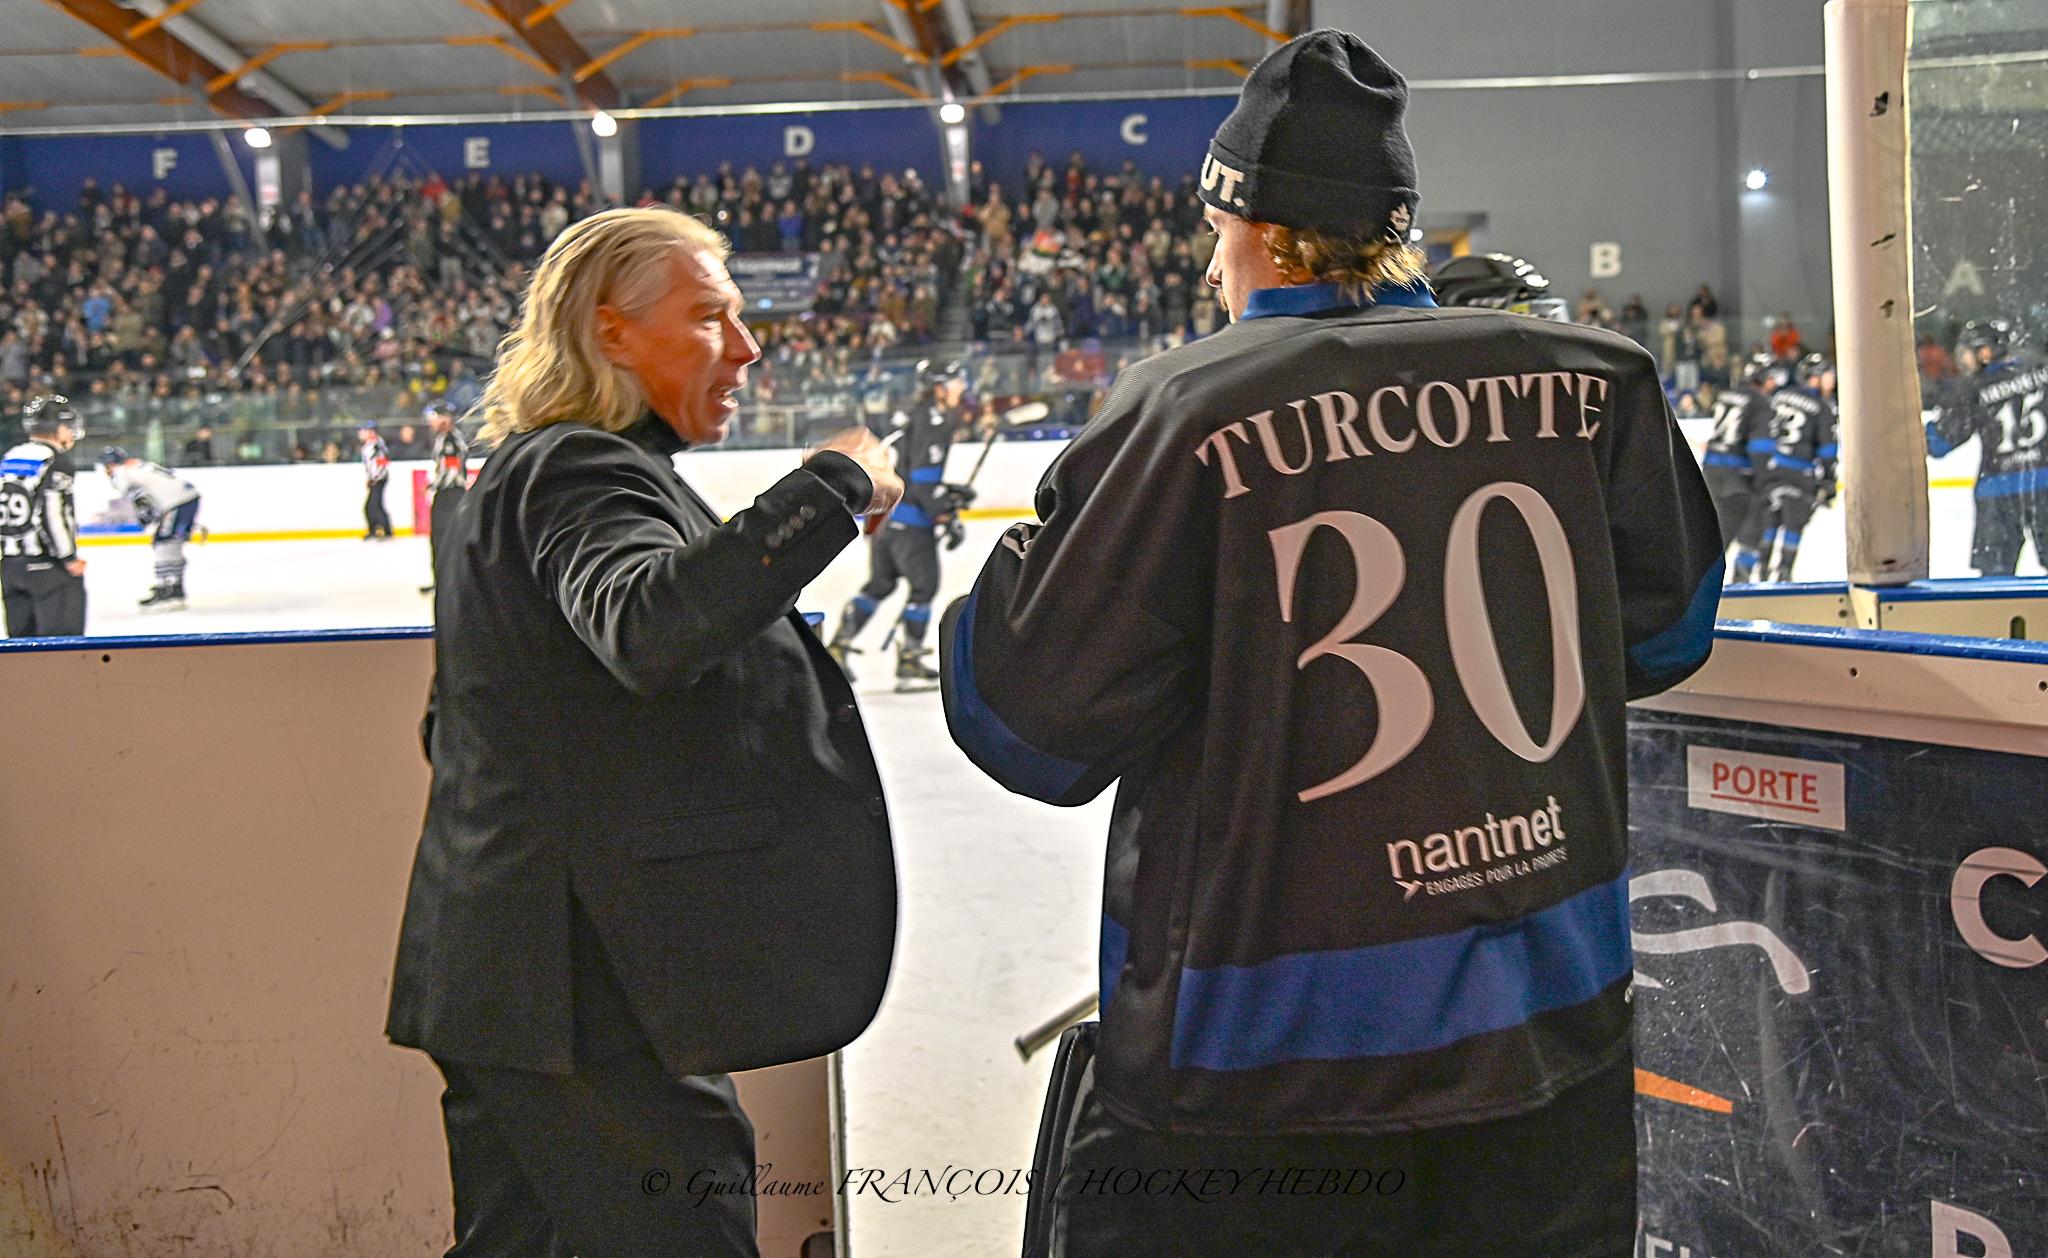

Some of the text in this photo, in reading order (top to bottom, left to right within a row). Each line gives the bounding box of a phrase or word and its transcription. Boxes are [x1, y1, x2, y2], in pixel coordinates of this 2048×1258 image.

[784, 125, 815, 157] D
[1121, 113, 1148, 145] C
[152, 148, 178, 180] F
[464, 136, 491, 169] E
[1589, 241, 1622, 278] B
[1943, 259, 1984, 296] A
[1195, 372, 1608, 499] TURCOTTE
[1994, 387, 2048, 454] 15
[1268, 481, 1585, 802] 30
[1712, 762, 1818, 805] PORTE
[1387, 795, 1566, 879] nantnet
